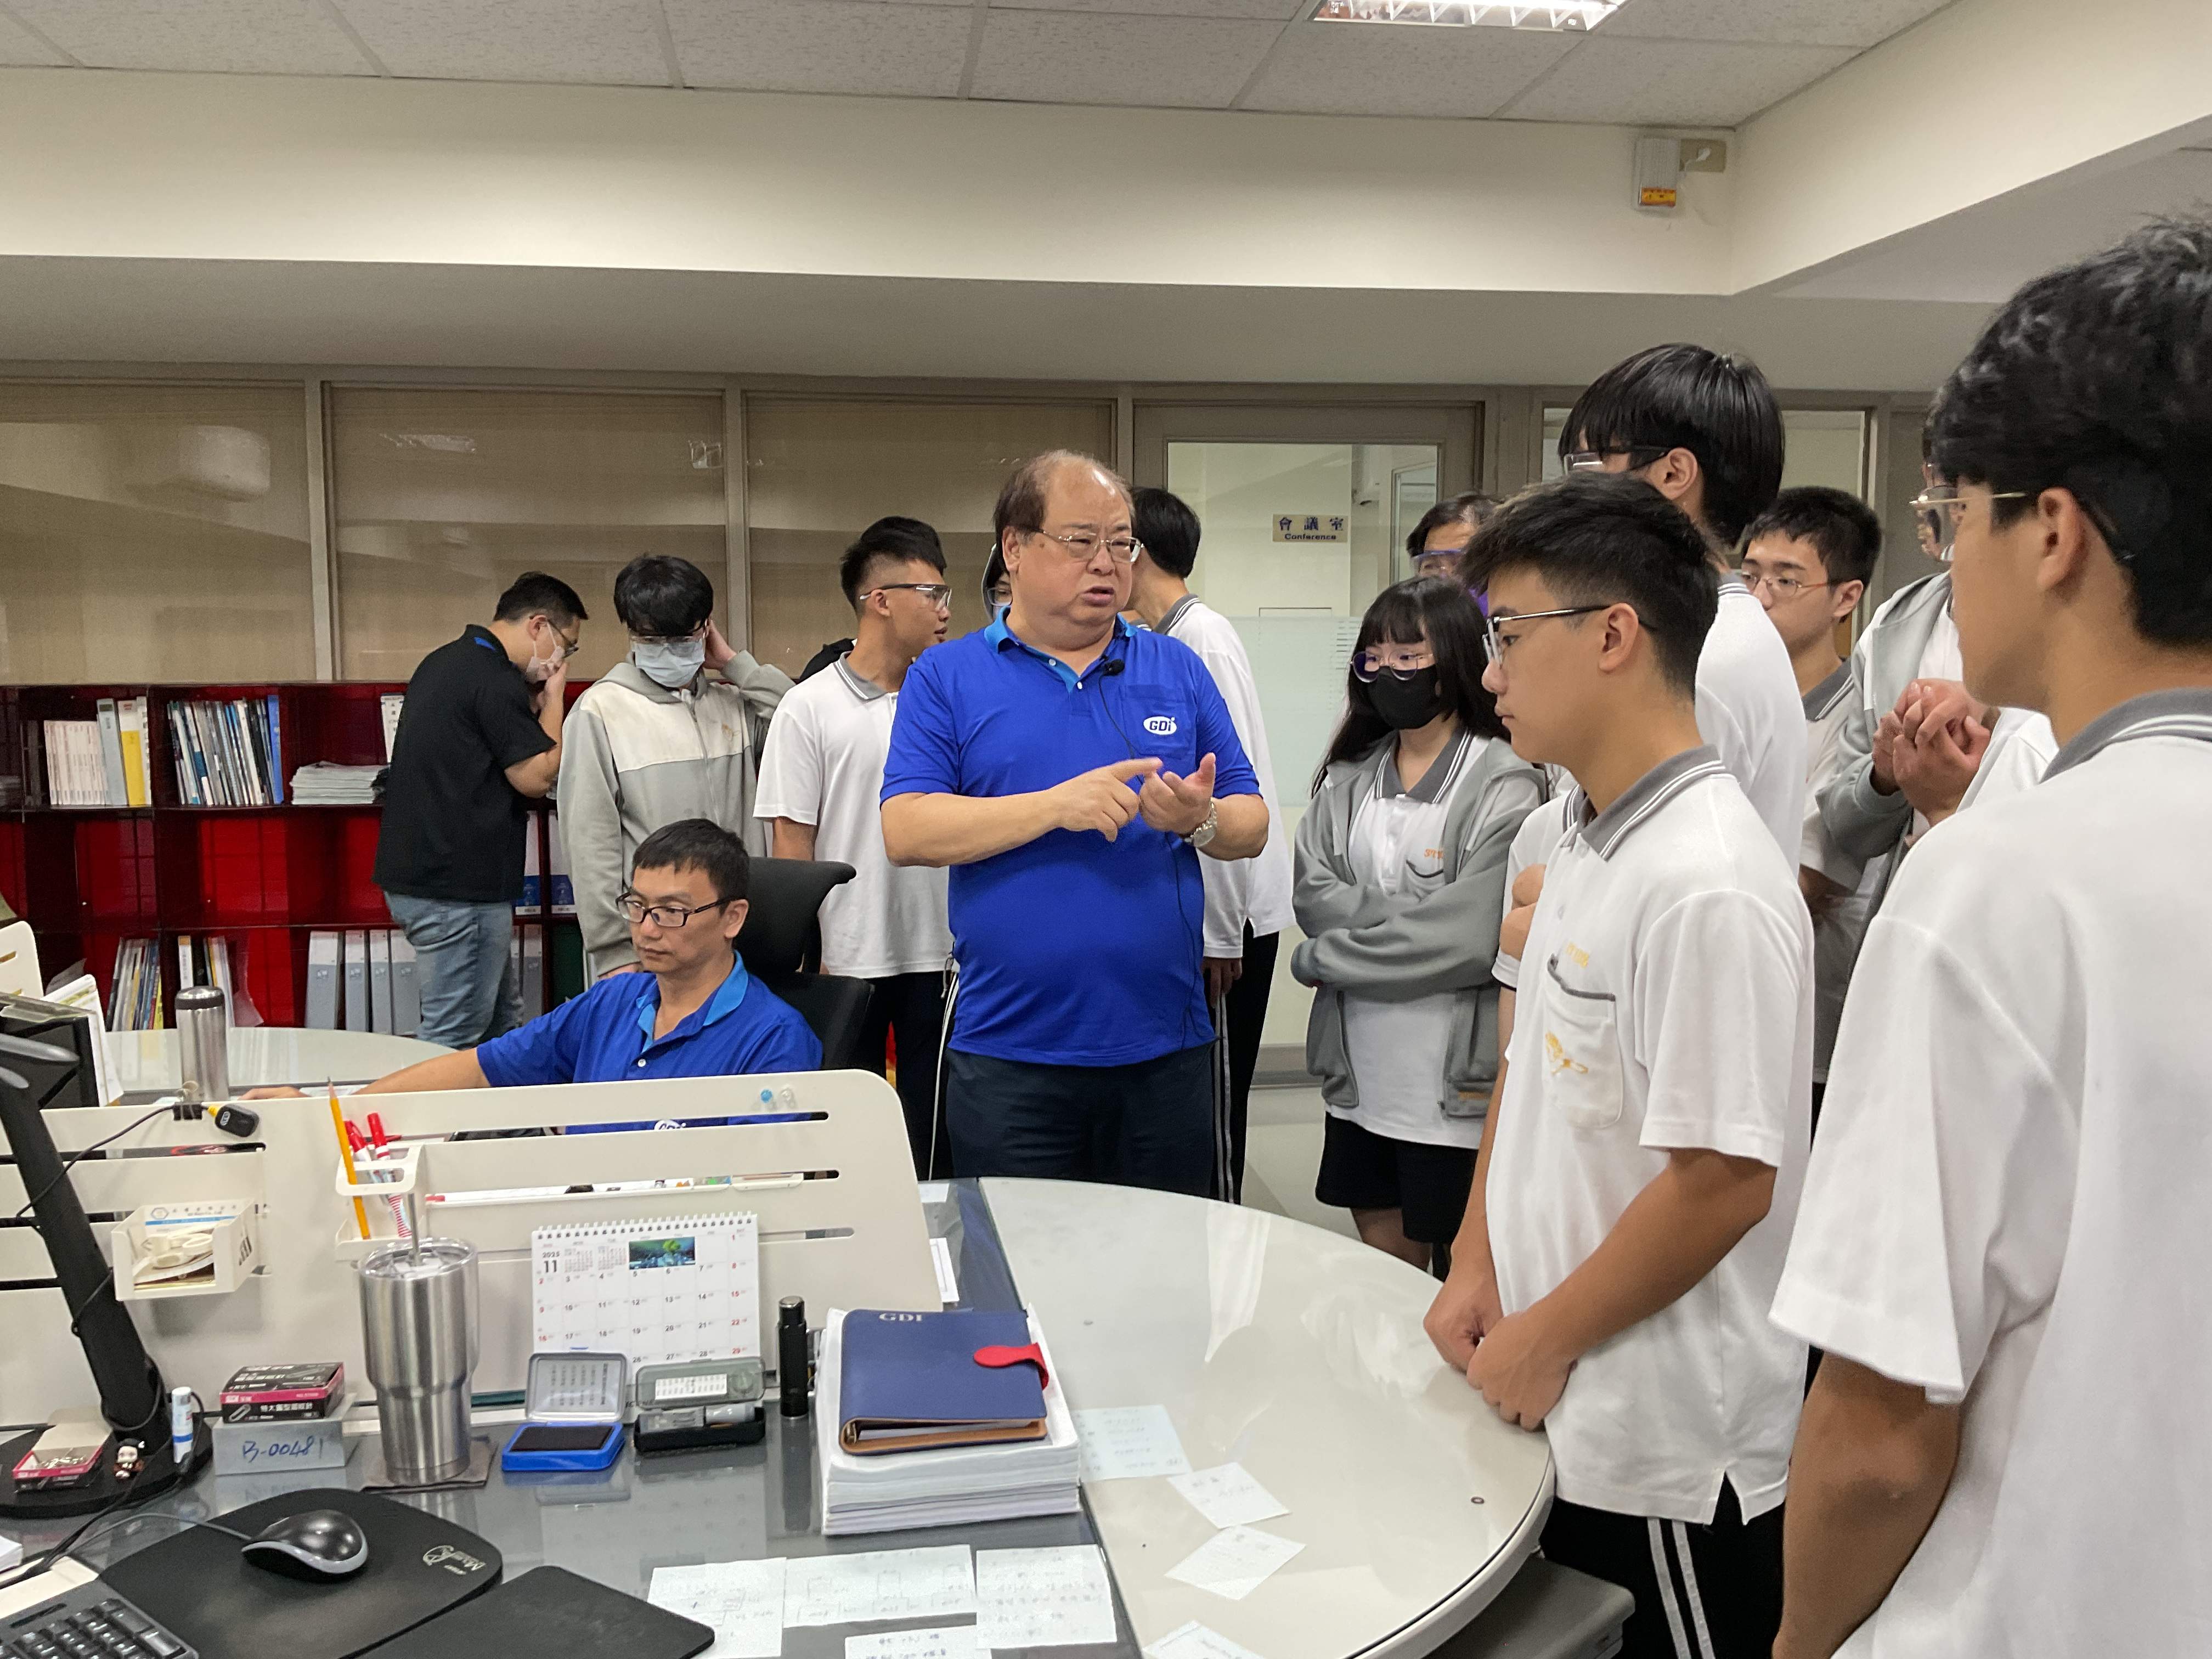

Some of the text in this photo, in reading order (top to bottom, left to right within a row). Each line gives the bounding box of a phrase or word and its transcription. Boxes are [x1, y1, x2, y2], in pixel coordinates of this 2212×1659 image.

[1279, 516, 1344, 531] 會議室
[1149, 720, 1171, 732] GDi
[544, 1260, 557, 1273] 11
[879, 1313, 922, 1322] GDI
